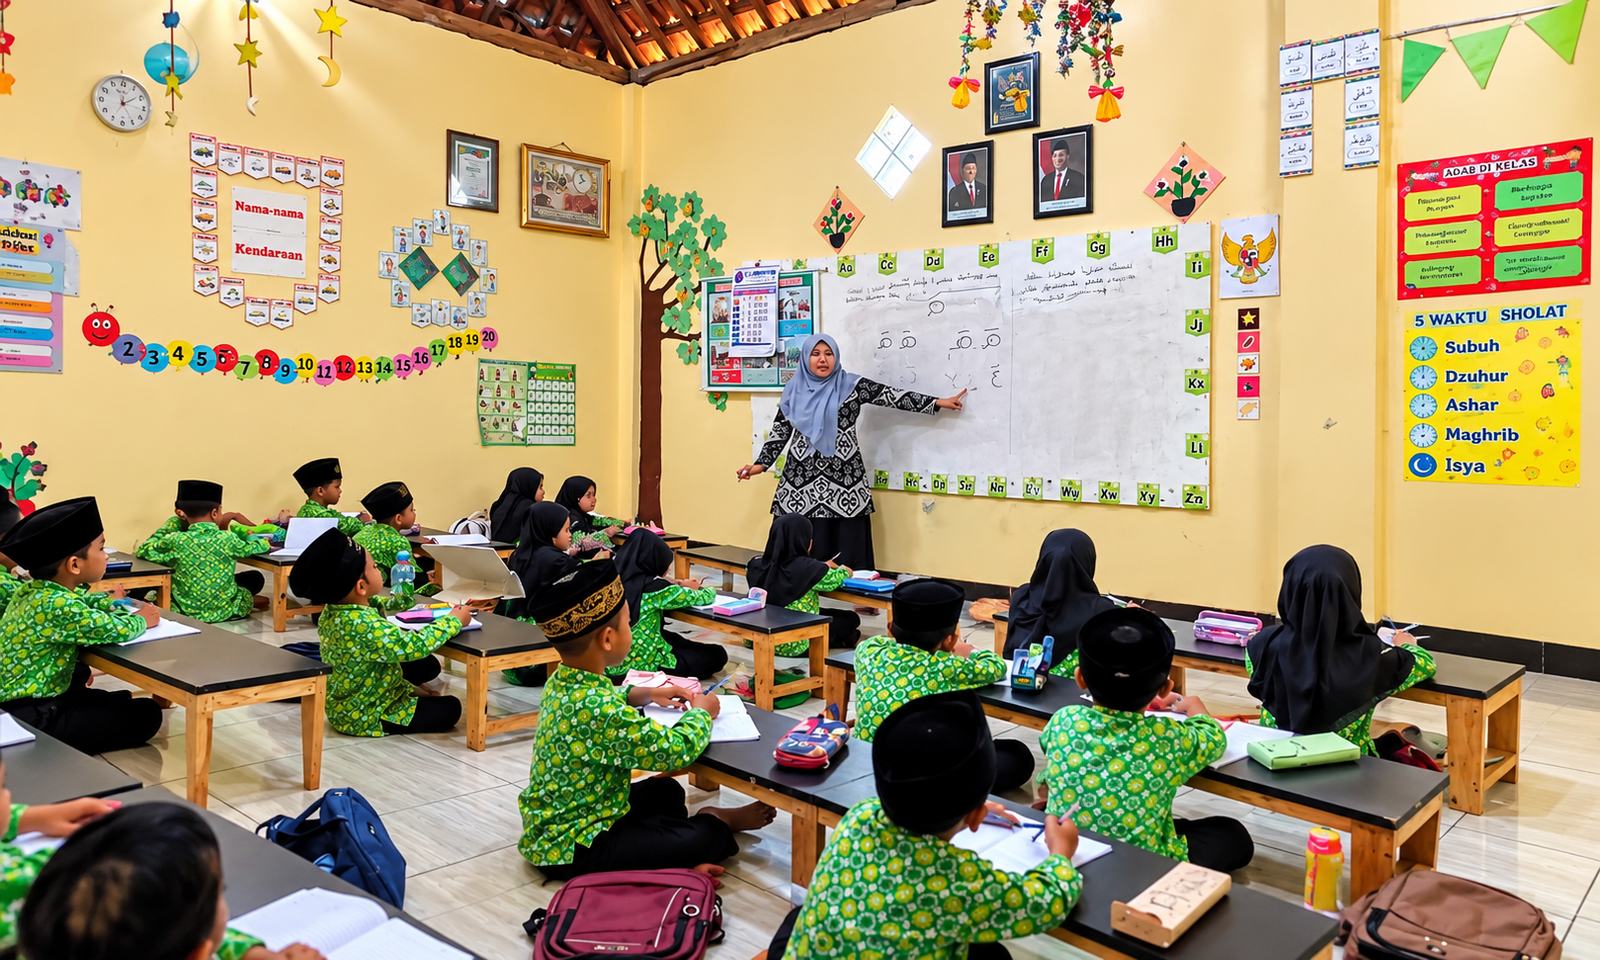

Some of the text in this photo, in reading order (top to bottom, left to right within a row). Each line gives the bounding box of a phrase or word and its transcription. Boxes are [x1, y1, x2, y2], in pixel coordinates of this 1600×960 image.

[1445, 157, 1536, 177] ADAB DI KELAS
[235, 201, 304, 219] Nama-nama
[1155, 235, 1174, 248] Hh
[235, 243, 303, 261] Kendaraan
[1036, 246, 1049, 258] Ff
[1090, 242, 1106, 255] Gg
[926, 256, 940, 266] Dd
[982, 252, 995, 263] Ee
[839, 262, 852, 272] Aa
[880, 260, 894, 270] Cc
[1415, 305, 1567, 327] 5 WAKTU SHOLAT
[1190, 318, 1203, 332] Jj
[1445, 339, 1500, 354] Subuh
[123, 342, 134, 356] 2
[148, 350, 159, 365] 3
[172, 346, 184, 360] 4
[196, 352, 207, 366] 5
[240, 361, 250, 376] 7
[262, 355, 271, 369] 8
[281, 364, 290, 378] 9
[298, 358, 314, 370] 10
[337, 362, 352, 374] 12
[357, 362, 372, 374] 13
[376, 362, 392, 374] 14
[396, 359, 410, 372] 15
[414, 352, 428, 364] 16
[431, 344, 445, 356] 17
[448, 337, 462, 348] 18
[466, 334, 479, 346] 19
[482, 331, 495, 342] 20
[1445, 370, 1509, 383] Dzuhur
[1445, 398, 1499, 411] Ashar
[1445, 428, 1519, 444] Maghrib
[1445, 458, 1485, 475] Isya
[1061, 486, 1080, 500] Wy
[1100, 489, 1117, 500] Xw
